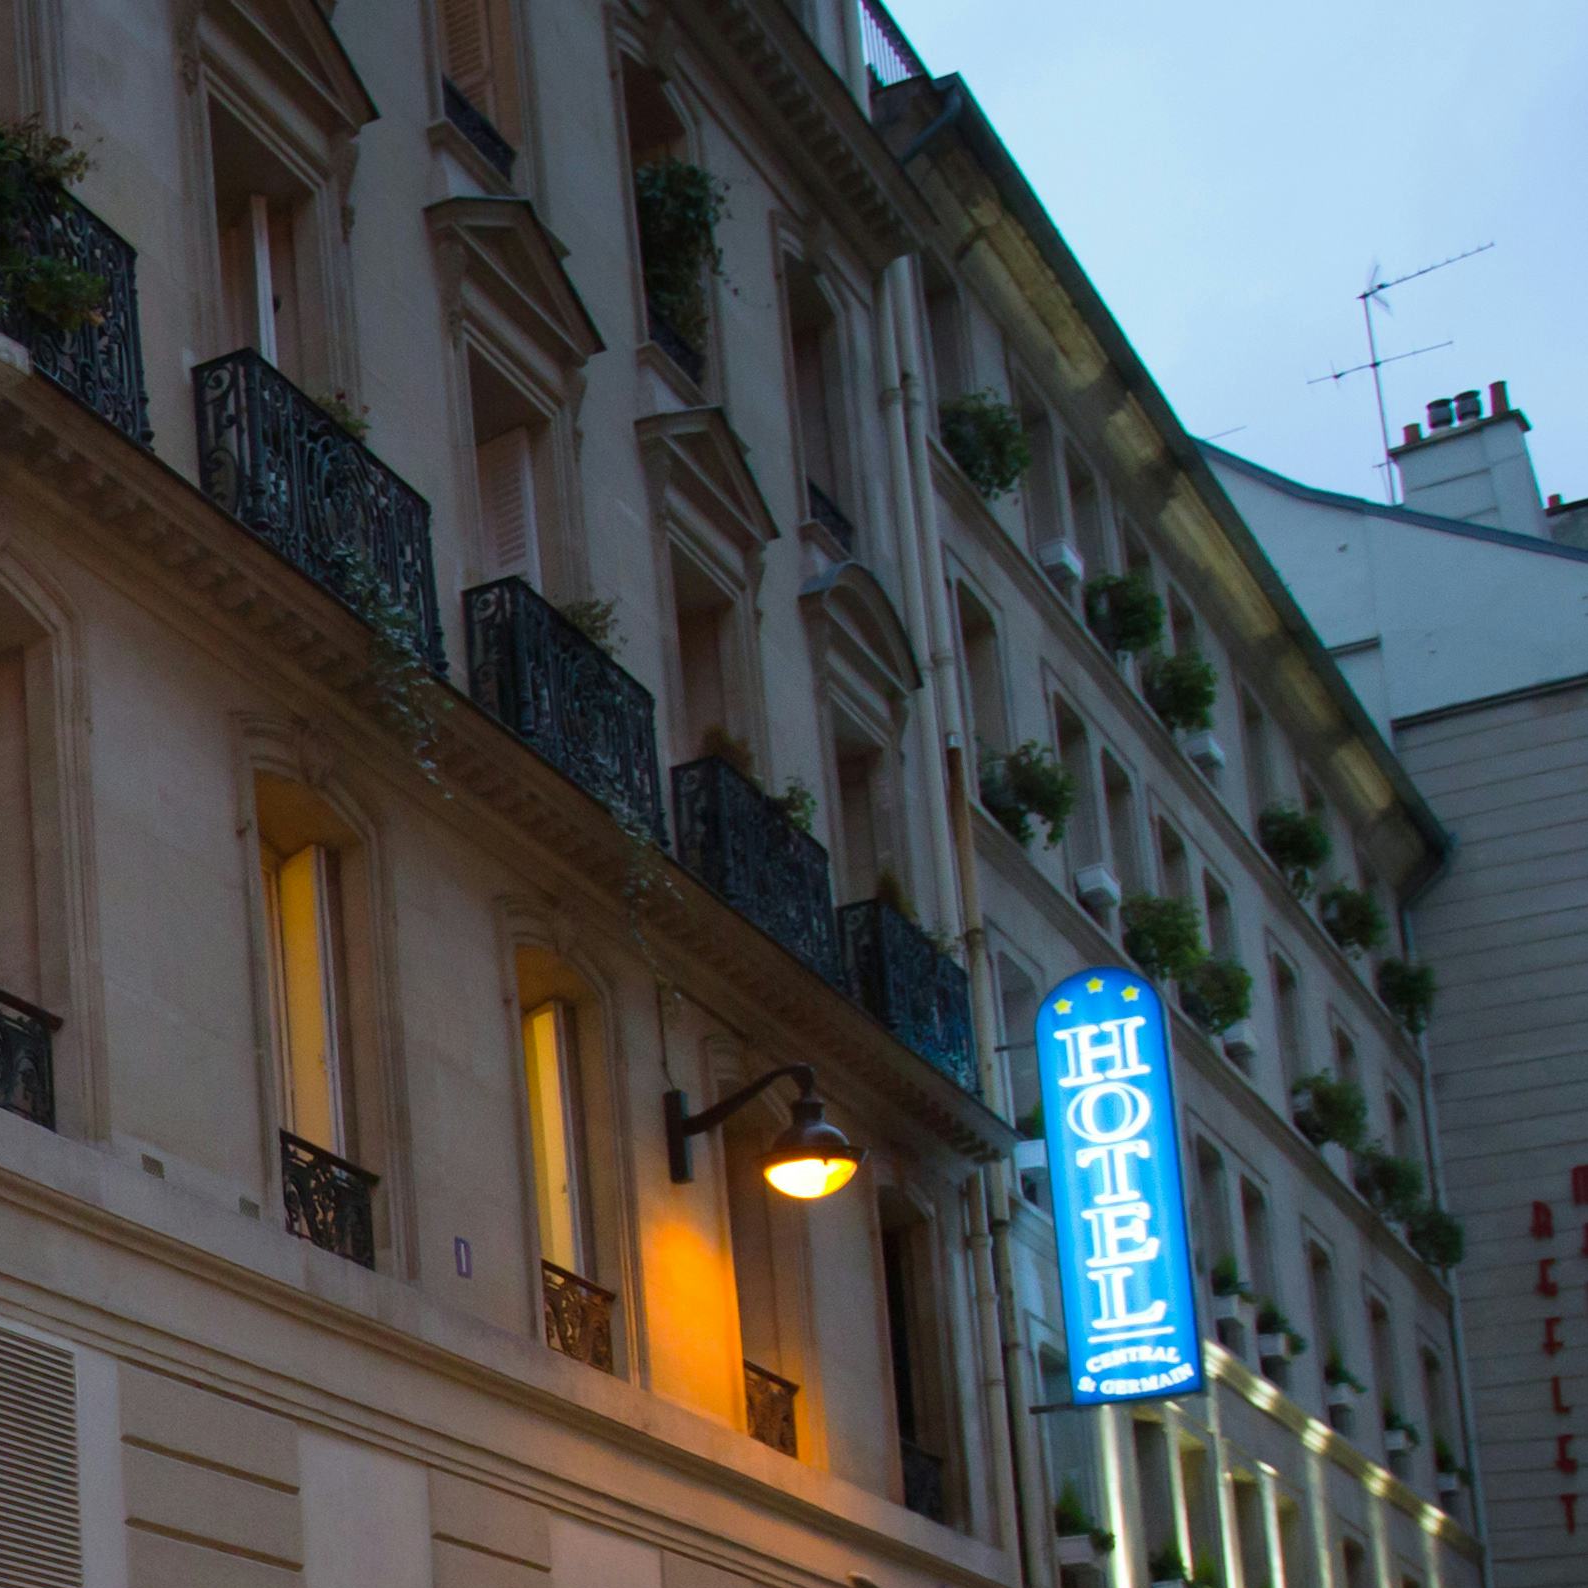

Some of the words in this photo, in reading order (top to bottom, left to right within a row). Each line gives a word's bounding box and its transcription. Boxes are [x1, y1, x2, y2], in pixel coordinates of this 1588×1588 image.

[1053, 1017, 1168, 1331] HOTEL
[1086, 1346, 1181, 1373] CENTRAL
[1100, 1363, 1194, 1395] GERMAIN
